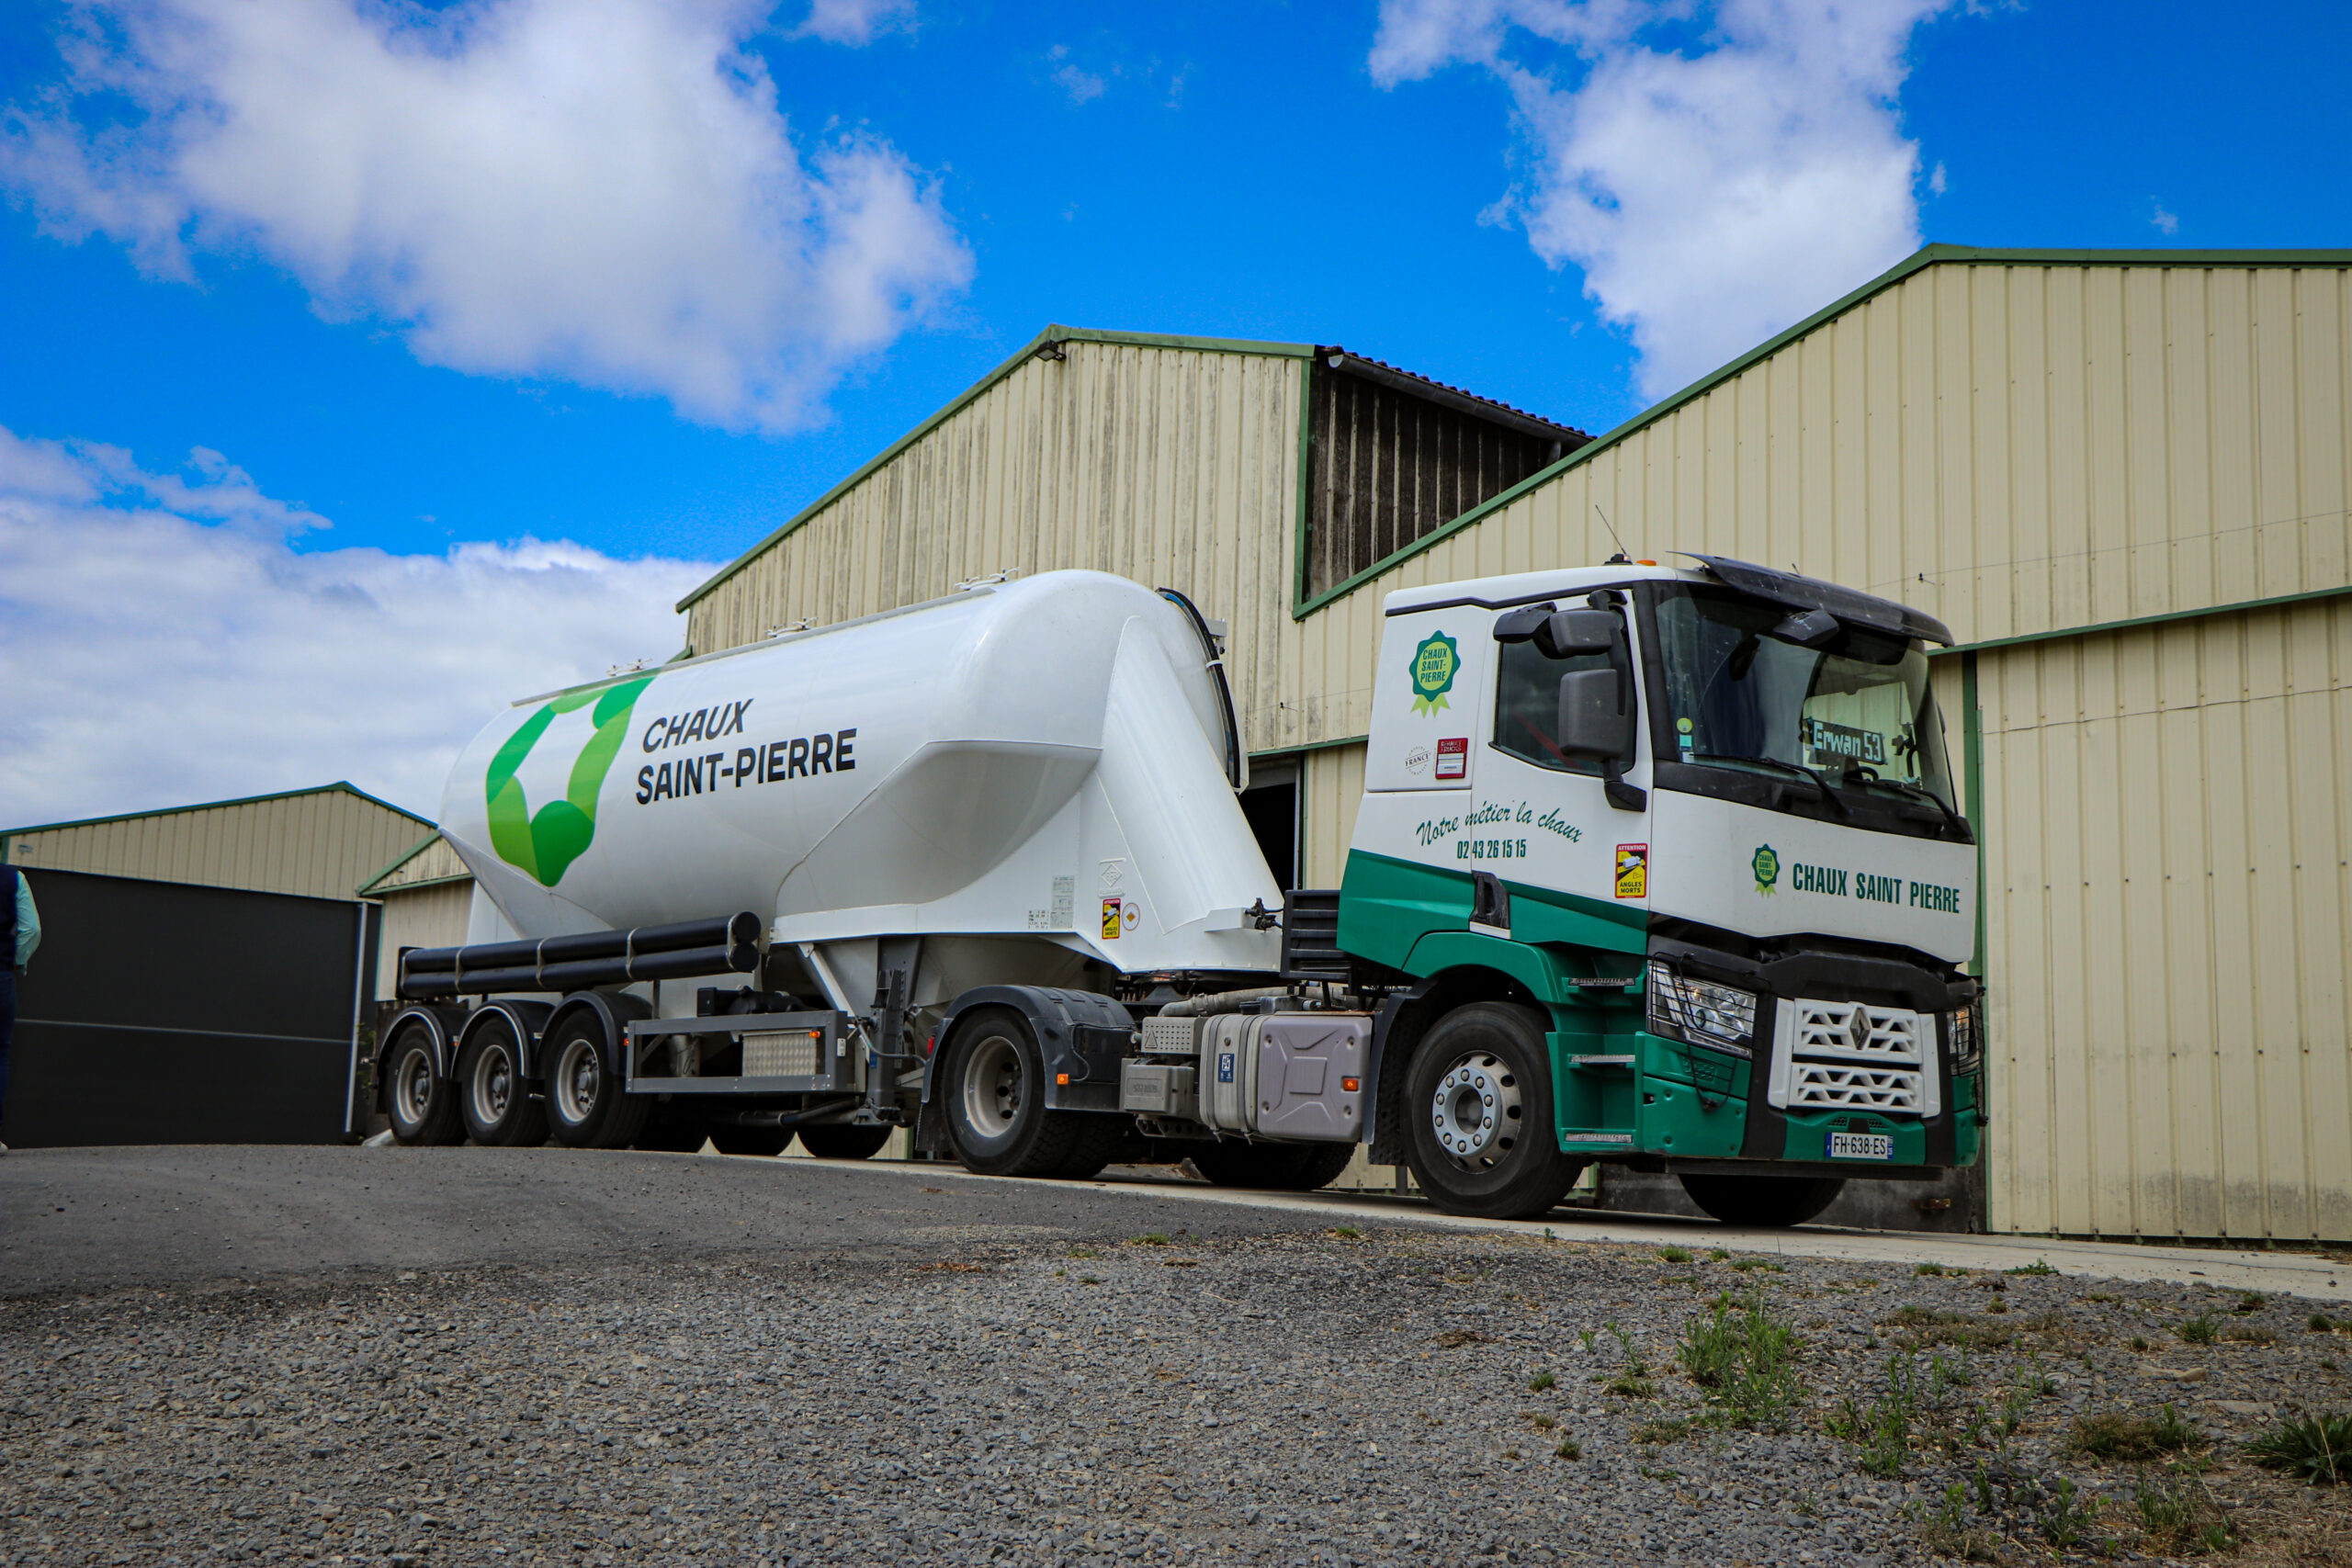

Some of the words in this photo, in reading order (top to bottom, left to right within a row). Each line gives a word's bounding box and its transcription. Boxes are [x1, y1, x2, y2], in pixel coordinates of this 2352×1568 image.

[1423, 648, 1448, 660] CHAUX
[1421, 660, 1446, 671] SAINT-
[1420, 671, 1446, 682] PIERRE
[643, 698, 754, 753] CHAUX
[1814, 721, 1861, 757] Erwan
[1863, 731, 1883, 762] 53
[636, 728, 857, 805] SAINT-PIERRE
[1405, 753, 1430, 767] FRANCE
[1416, 816, 1459, 846] Notre
[1464, 800, 1511, 826] métier
[1516, 801, 1533, 825] la
[1537, 807, 1584, 843] chaux
[1457, 840, 1470, 859] 02
[1472, 840, 1485, 859] 43
[1487, 840, 1499, 859] 26
[1502, 839, 1513, 858] 15
[1516, 839, 1527, 858] 15
[1793, 863, 1848, 897] CHAUX
[1856, 872, 1903, 905] SAINT
[1909, 881, 1961, 914] PIERRE
[1834, 1135, 1886, 1155] FH-638-ES
